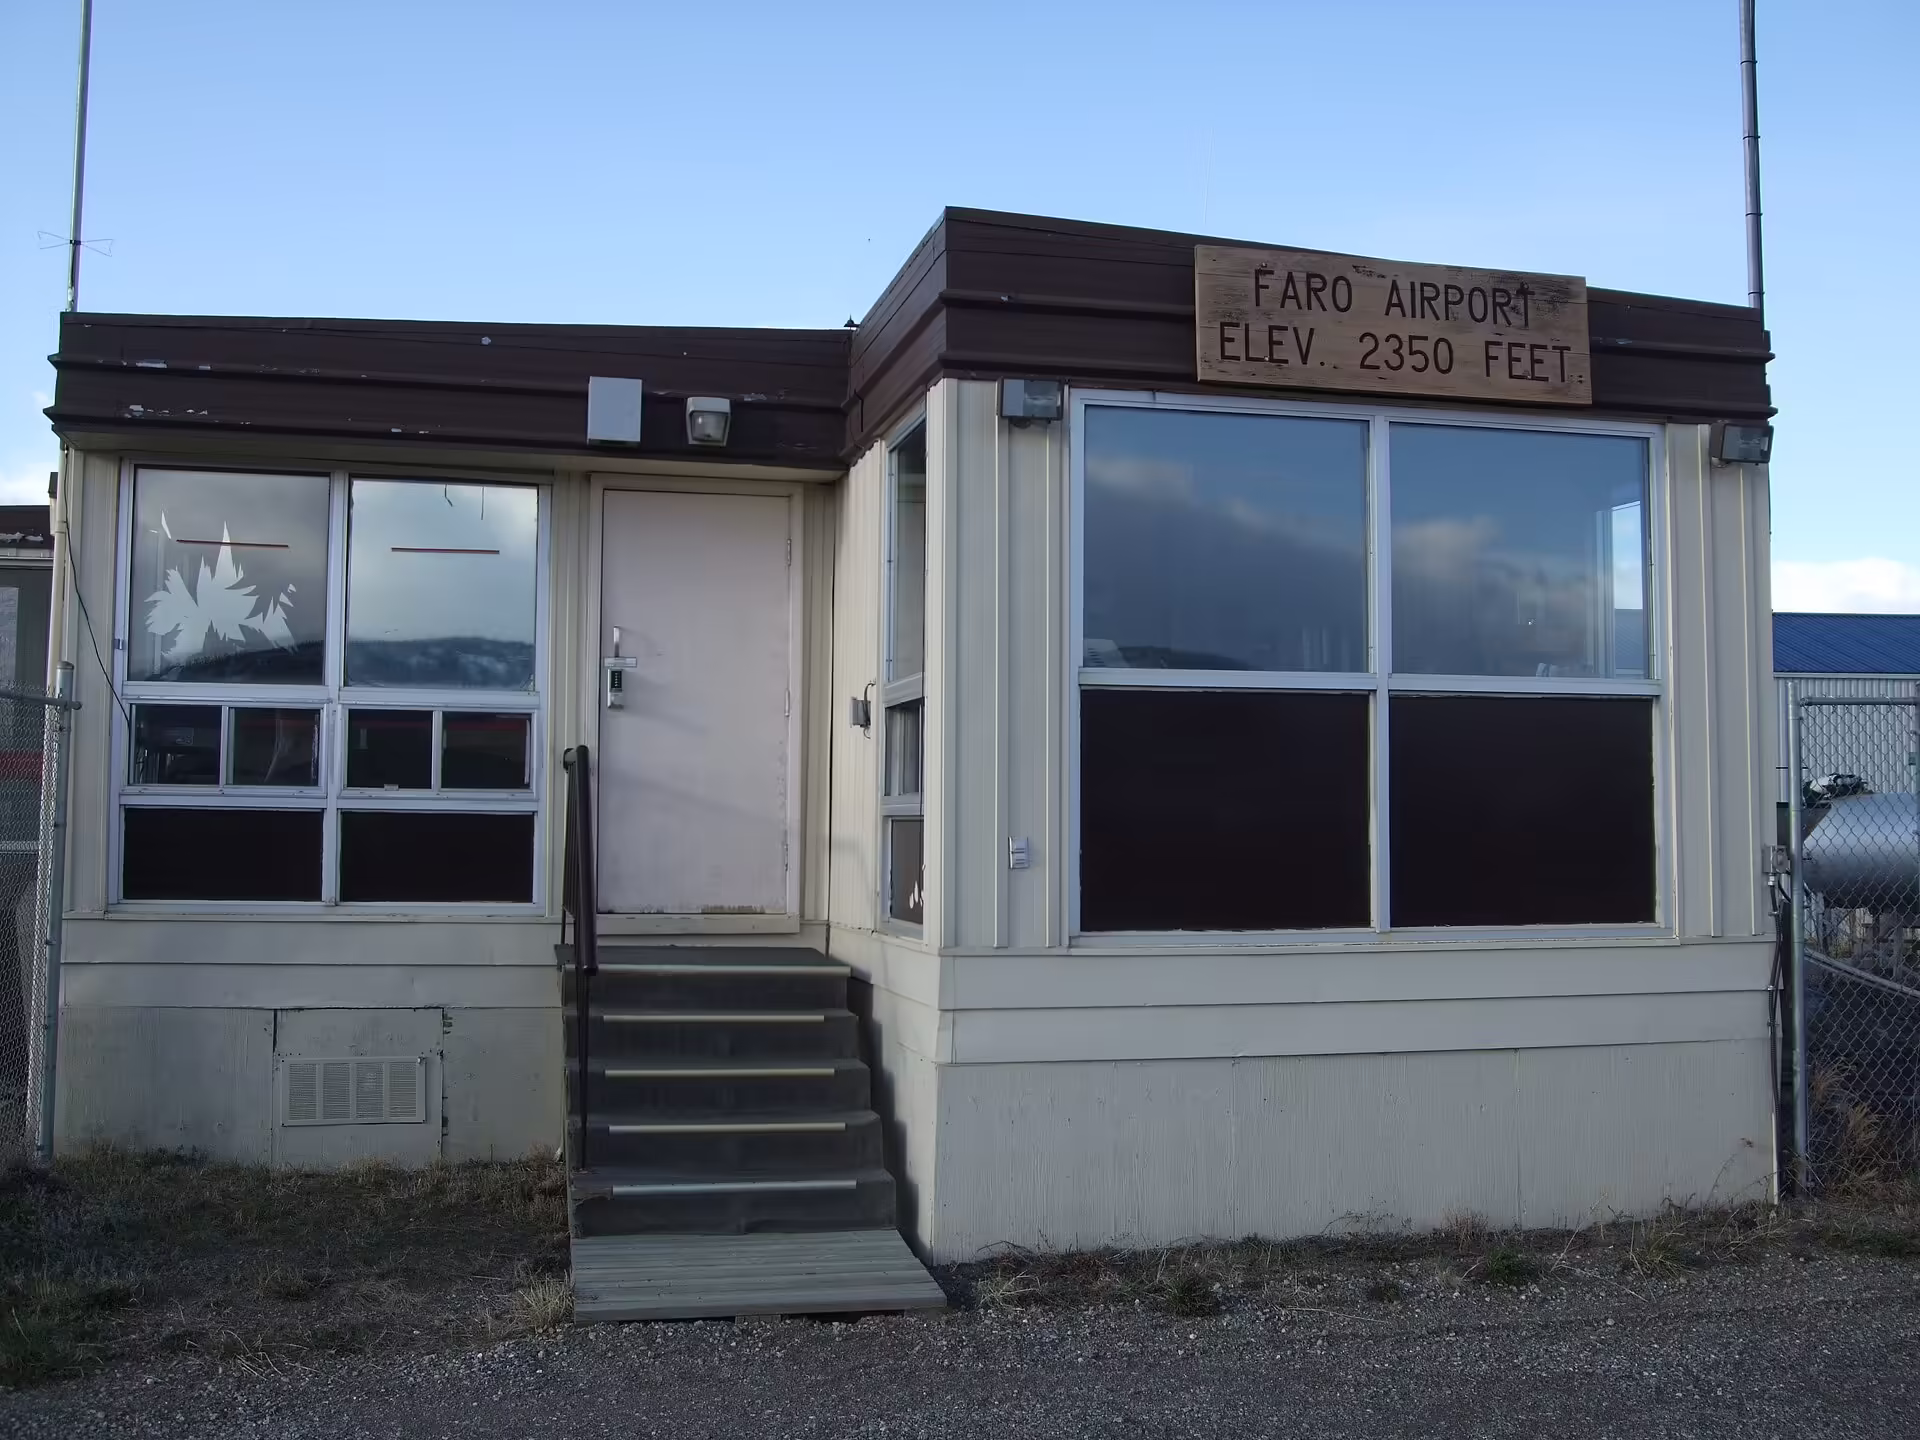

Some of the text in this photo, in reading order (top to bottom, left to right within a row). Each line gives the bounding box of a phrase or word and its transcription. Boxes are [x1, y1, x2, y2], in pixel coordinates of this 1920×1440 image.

[1254, 268, 1536, 328] FARO AIRPORT
[1219, 321, 1572, 383] ELEV. 2350 FEET
